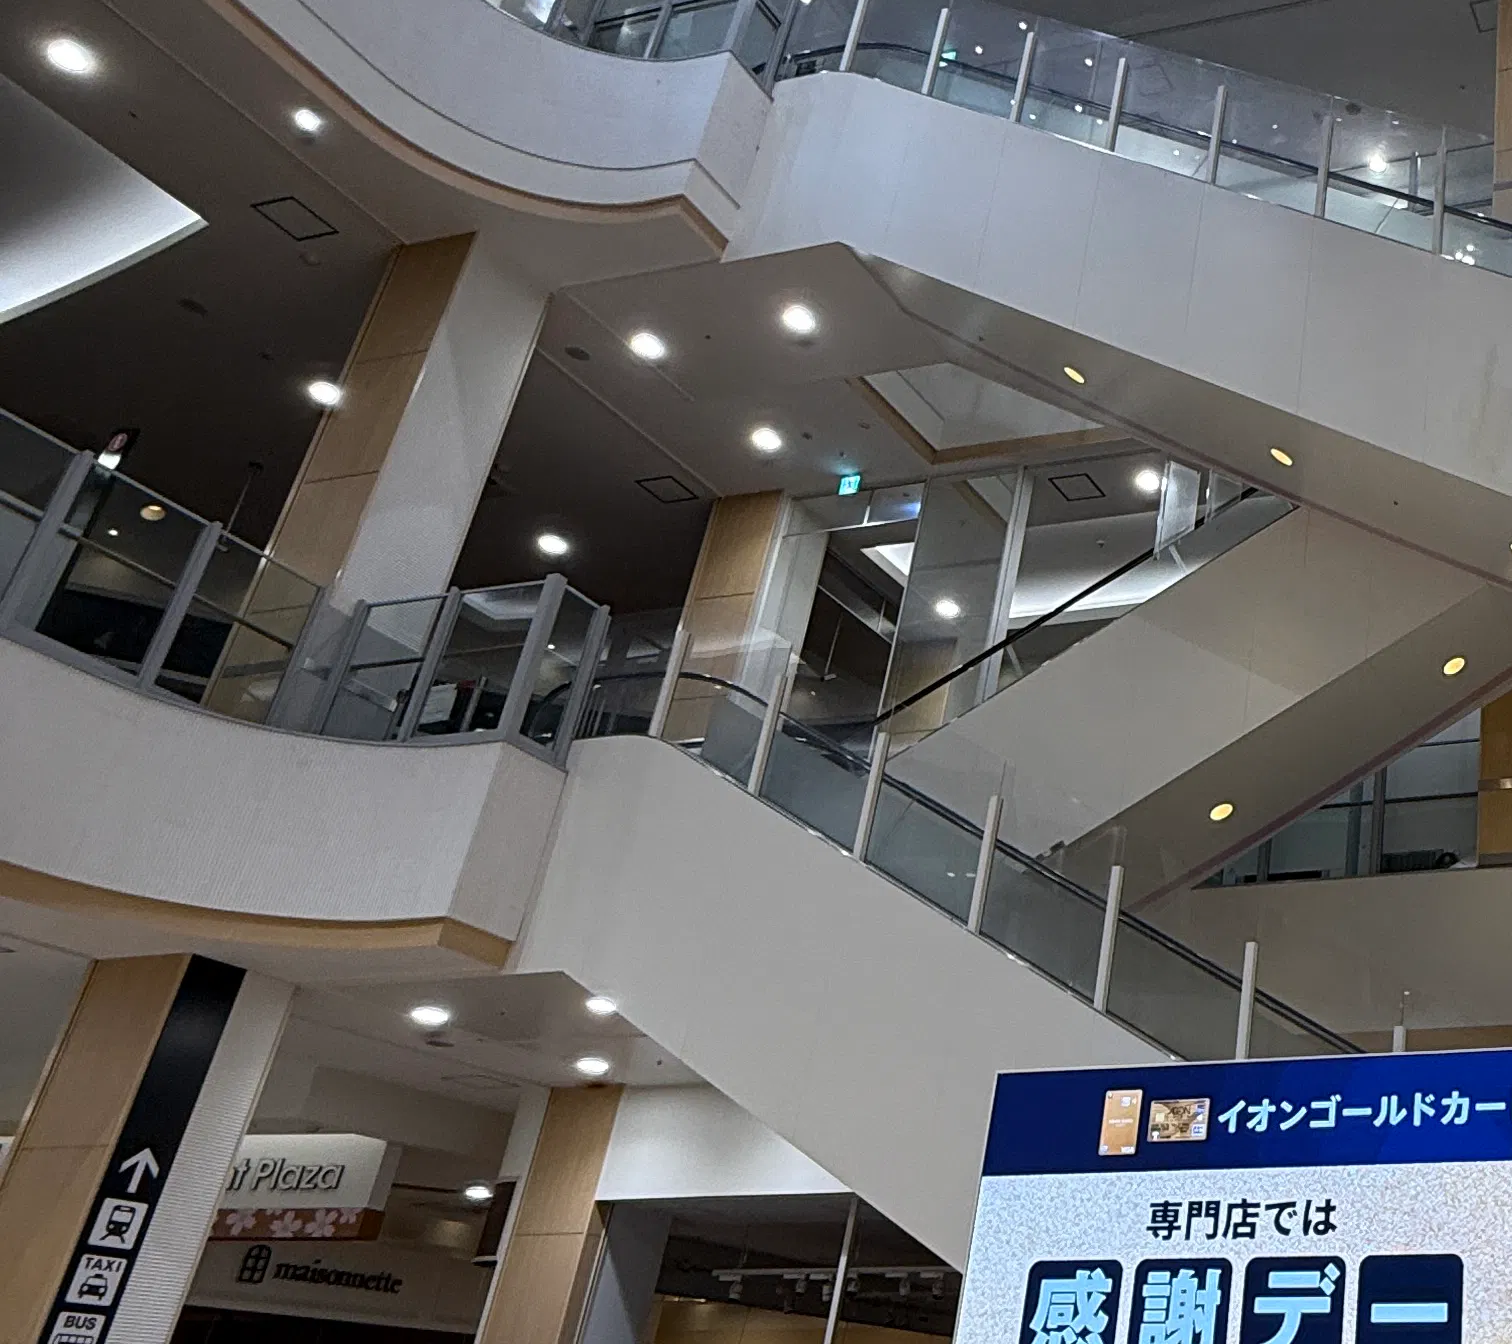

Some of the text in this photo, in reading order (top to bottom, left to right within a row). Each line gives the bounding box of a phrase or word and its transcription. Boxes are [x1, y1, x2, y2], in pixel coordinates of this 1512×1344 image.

[250, 1157, 346, 1192] Plaza
[1145, 1198, 1338, 1242] 専門店では
[83, 1255, 122, 1274] TAXI
[273, 1259, 404, 1295] maisonnette
[62, 1315, 97, 1332] BUS
